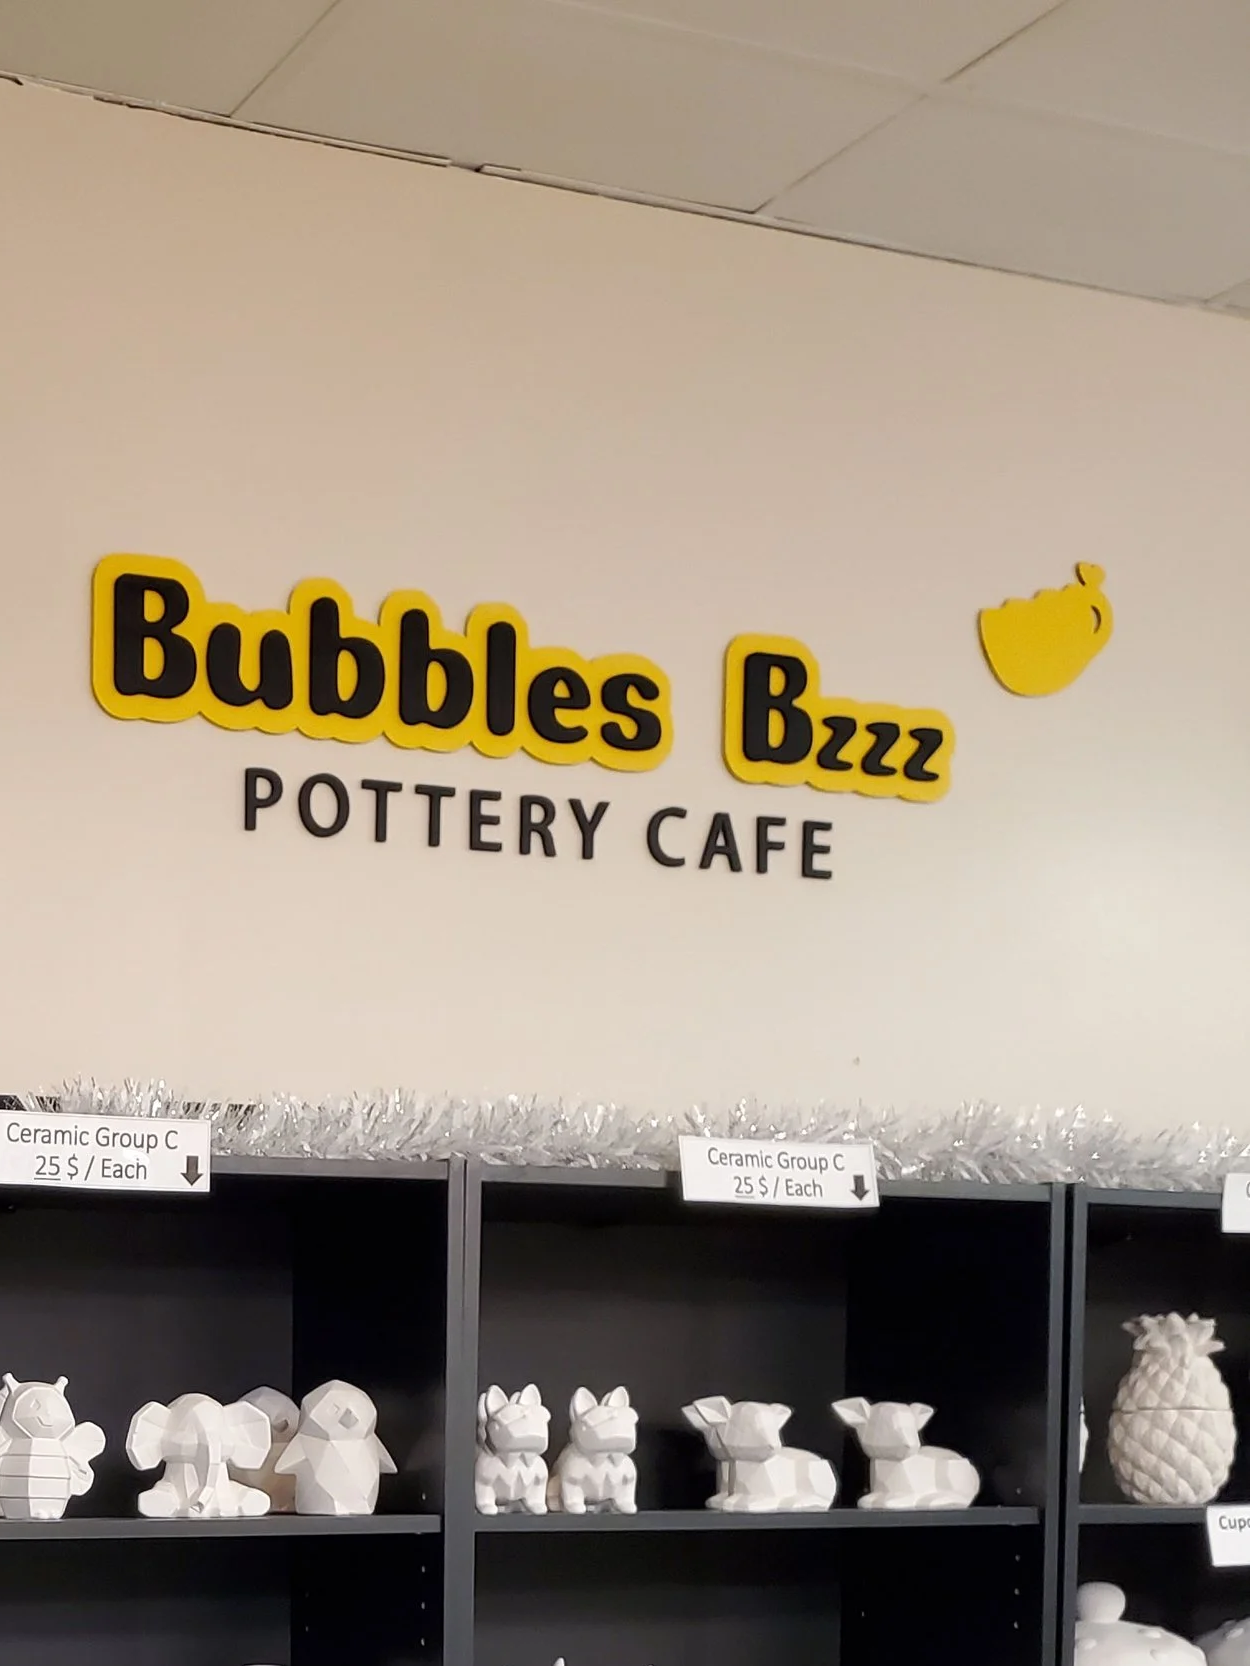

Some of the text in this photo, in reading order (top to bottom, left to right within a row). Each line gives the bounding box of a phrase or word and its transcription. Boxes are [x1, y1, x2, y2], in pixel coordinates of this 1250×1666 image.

[112, 573, 944, 783] Bubbles Bzzz
[244, 767, 833, 880] POTTERY CAFE
[6, 1122, 179, 1154] Ceramic Group C
[34, 1153, 148, 1181] 25 $ / Each
[707, 1147, 845, 1174] Ceramic Group C
[734, 1175, 824, 1199] 25 $ / Each
